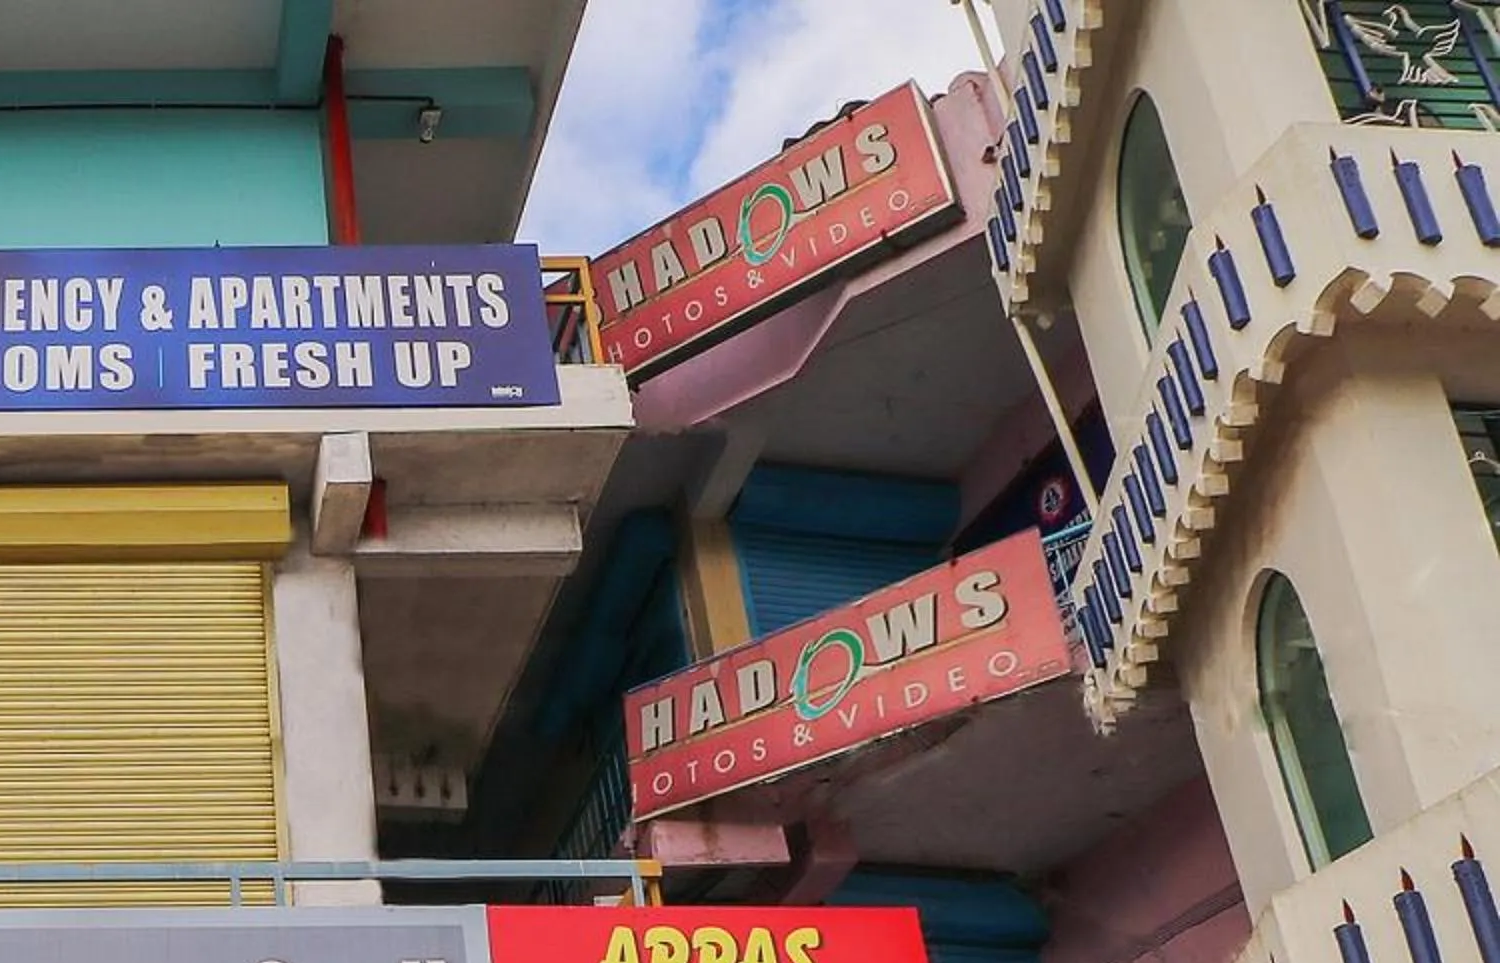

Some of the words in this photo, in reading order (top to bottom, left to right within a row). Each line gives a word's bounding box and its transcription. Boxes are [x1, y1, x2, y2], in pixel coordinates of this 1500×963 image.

[747, 269, 765, 287] &
[781, 190, 910, 270] VIDEO
[140, 285, 173, 331] &
[188, 274, 509, 329] APARTMENTS
[188, 342, 374, 388] FRESH
[394, 341, 472, 388] UP
[793, 725, 813, 746] &
[837, 651, 1019, 729] VIDEO
